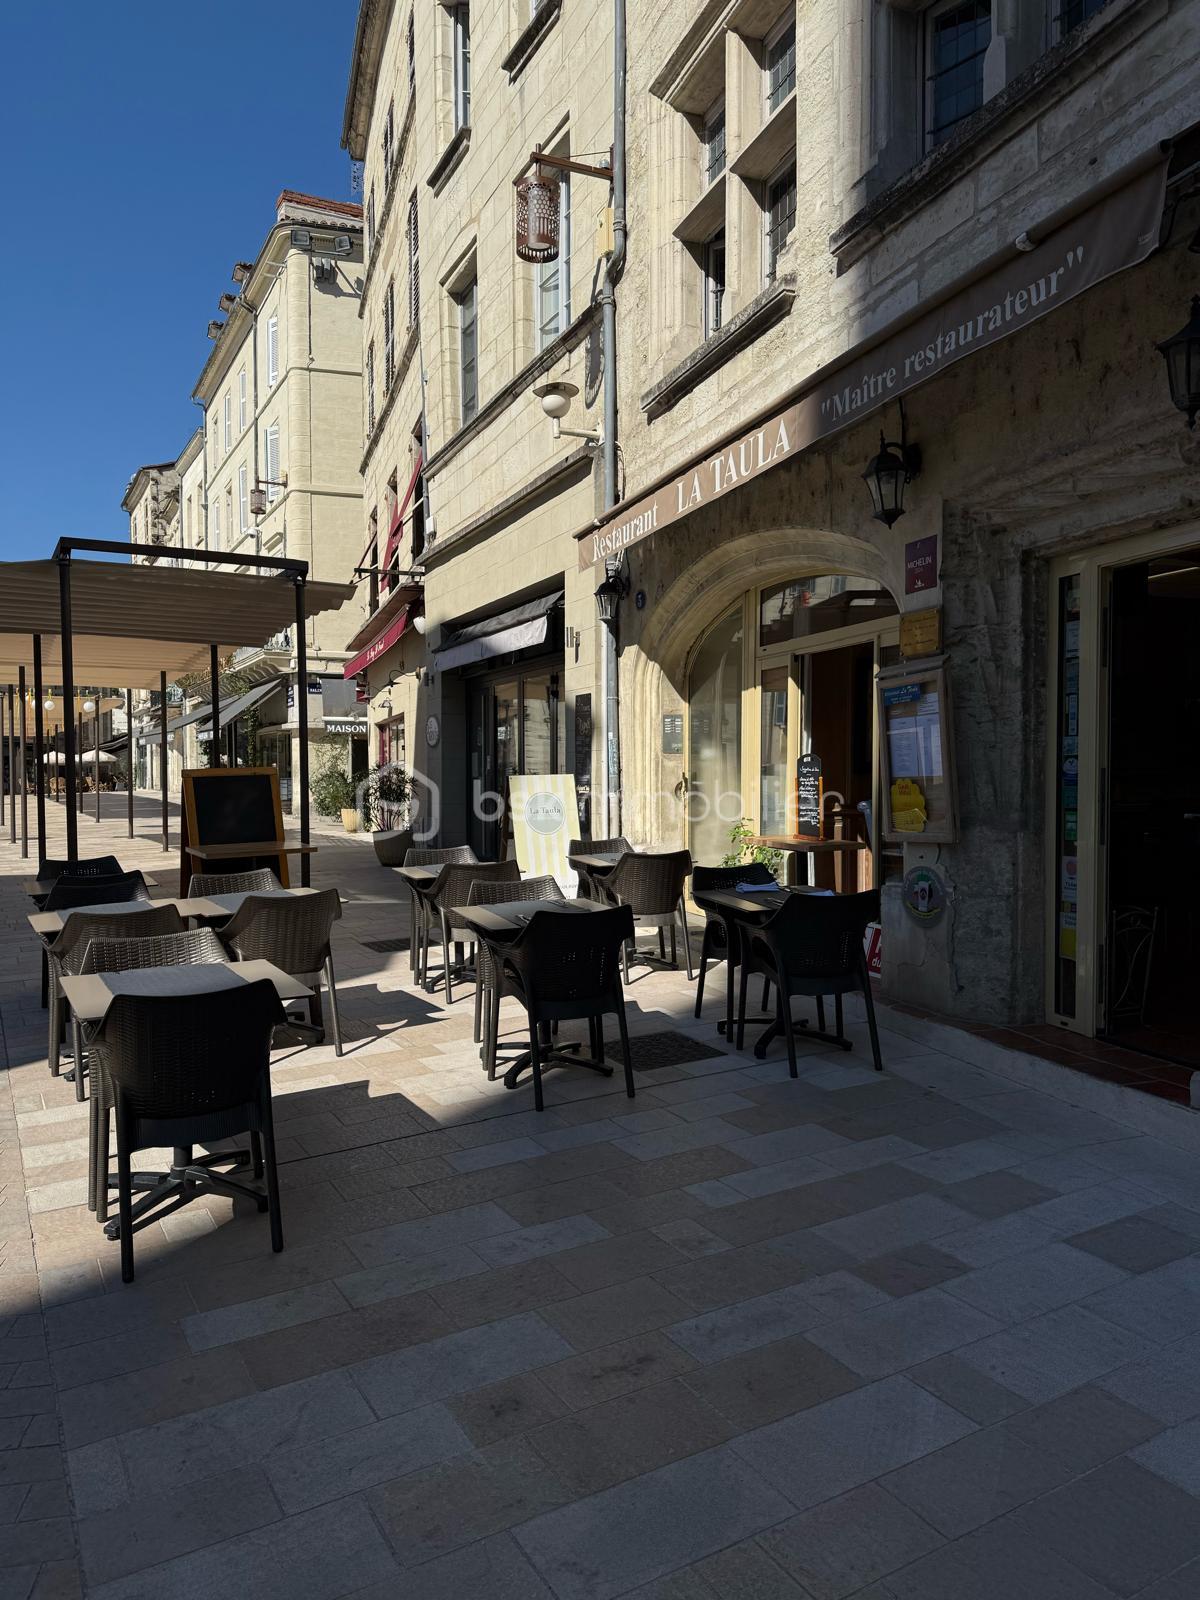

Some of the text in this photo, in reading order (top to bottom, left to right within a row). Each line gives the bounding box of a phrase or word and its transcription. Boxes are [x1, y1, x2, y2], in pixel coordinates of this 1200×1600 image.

[592, 500, 659, 562] Restaurant
[676, 472, 703, 515] LA
[710, 418, 791, 494] TAULA
[907, 555, 933, 569] MICHELIN
[326, 724, 368, 734] MAISON
[529, 806, 561, 815] La Taula
